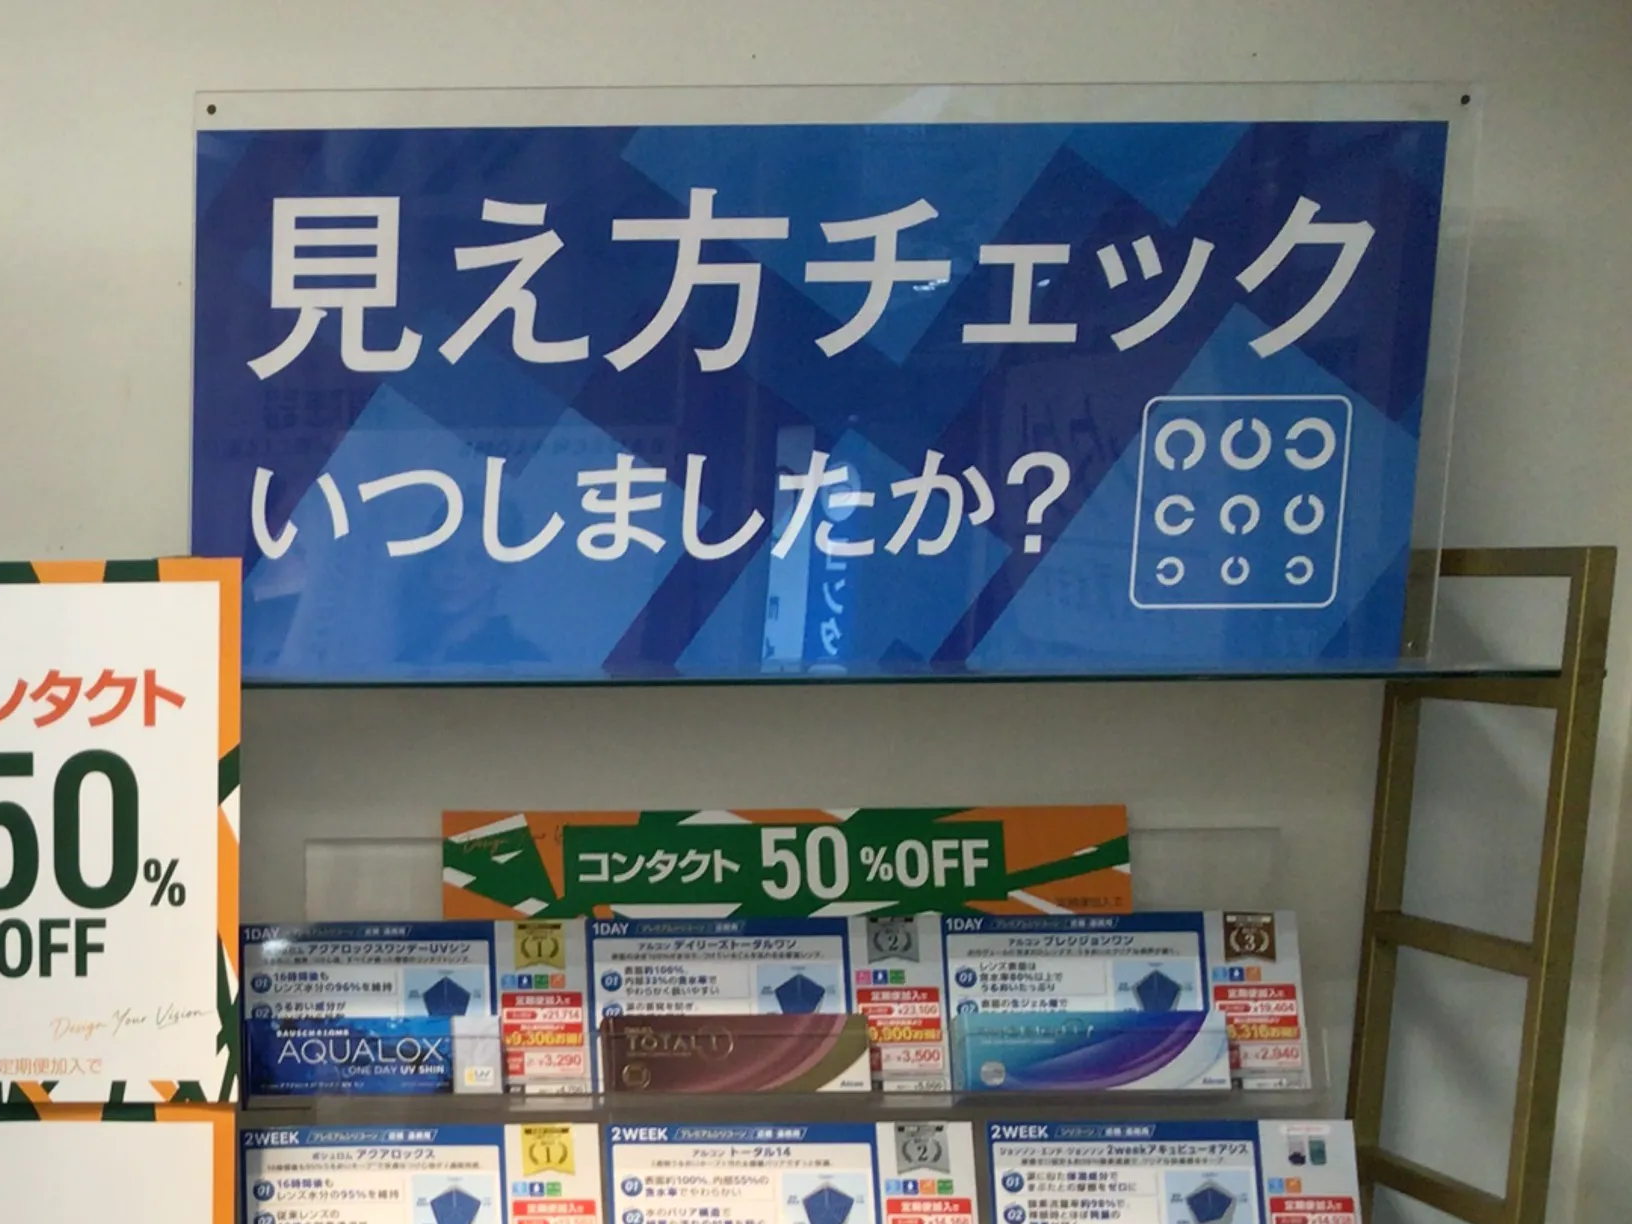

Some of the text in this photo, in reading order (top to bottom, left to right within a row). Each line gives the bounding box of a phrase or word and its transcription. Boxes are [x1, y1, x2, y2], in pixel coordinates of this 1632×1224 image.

[247, 186, 1378, 380] 見え方チェック
[250, 447, 1071, 565] いつしましたか?
[577, 848, 740, 885] コンタクト
[592, 922, 630, 936] 1DAY
[945, 918, 984, 931] 1DAY
[243, 928, 281, 940] 1DAY
[49, 1001, 215, 1041] Design Your Vision
[277, 1037, 446, 1065] AQUALOX
[348, 1065, 445, 1076] ONE DAY UV SHIN
[244, 1132, 300, 1146] 2WEEK
[611, 1127, 669, 1141] 2WEEK
[990, 1125, 1049, 1139] 2WEEK
[356, 1148, 435, 1160] アクアロックス
[729, 1146, 792, 1158] トータル14
